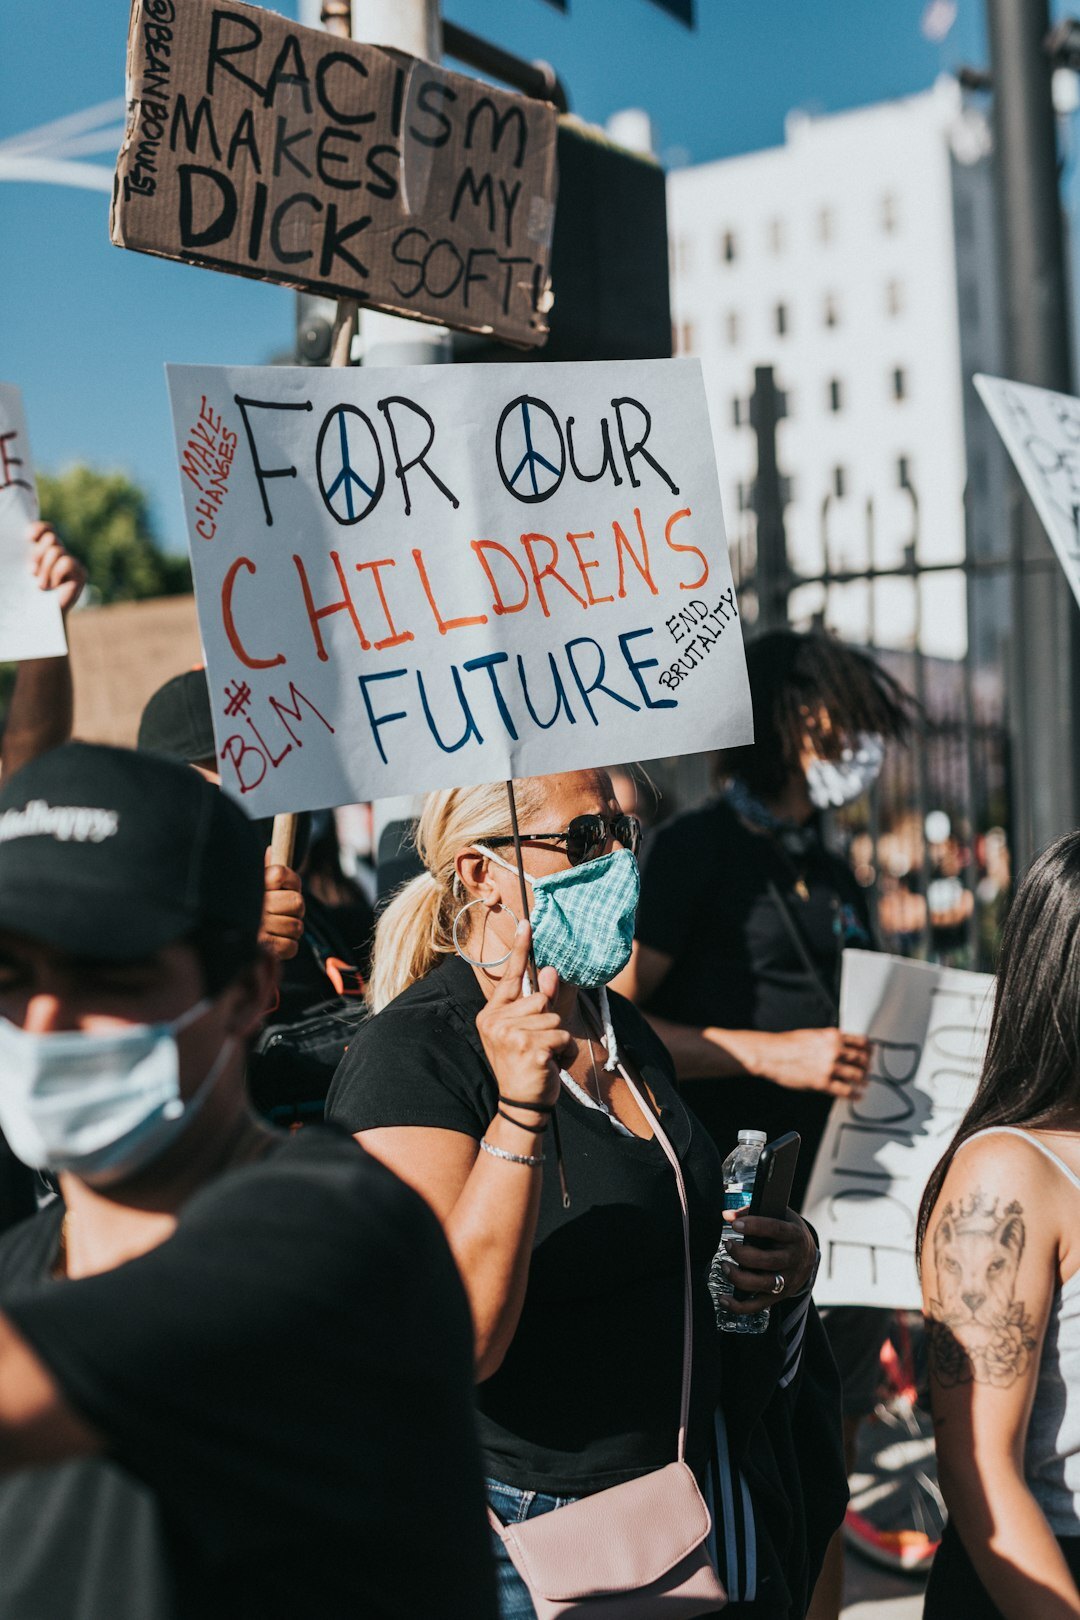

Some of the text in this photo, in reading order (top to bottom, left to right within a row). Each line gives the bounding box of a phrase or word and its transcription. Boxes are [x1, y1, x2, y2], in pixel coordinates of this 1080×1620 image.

[206, 9, 527, 168] RACISM
[169, 93, 523, 248] MAKES MY
[177, 163, 544, 316] DICK SOFT!
[181, 395, 223, 491] MAKE
[196, 431, 238, 541] CHANGES
[233, 394, 681, 526] FOR OUR
[221, 507, 709, 670] CHILDRENS
[658, 587, 738, 691] BRUTALITY
[665, 600, 709, 644] END
[221, 681, 334, 794] BLM
[358, 627, 679, 765] FUTURE
[828, 1039, 925, 1285] POLICE
